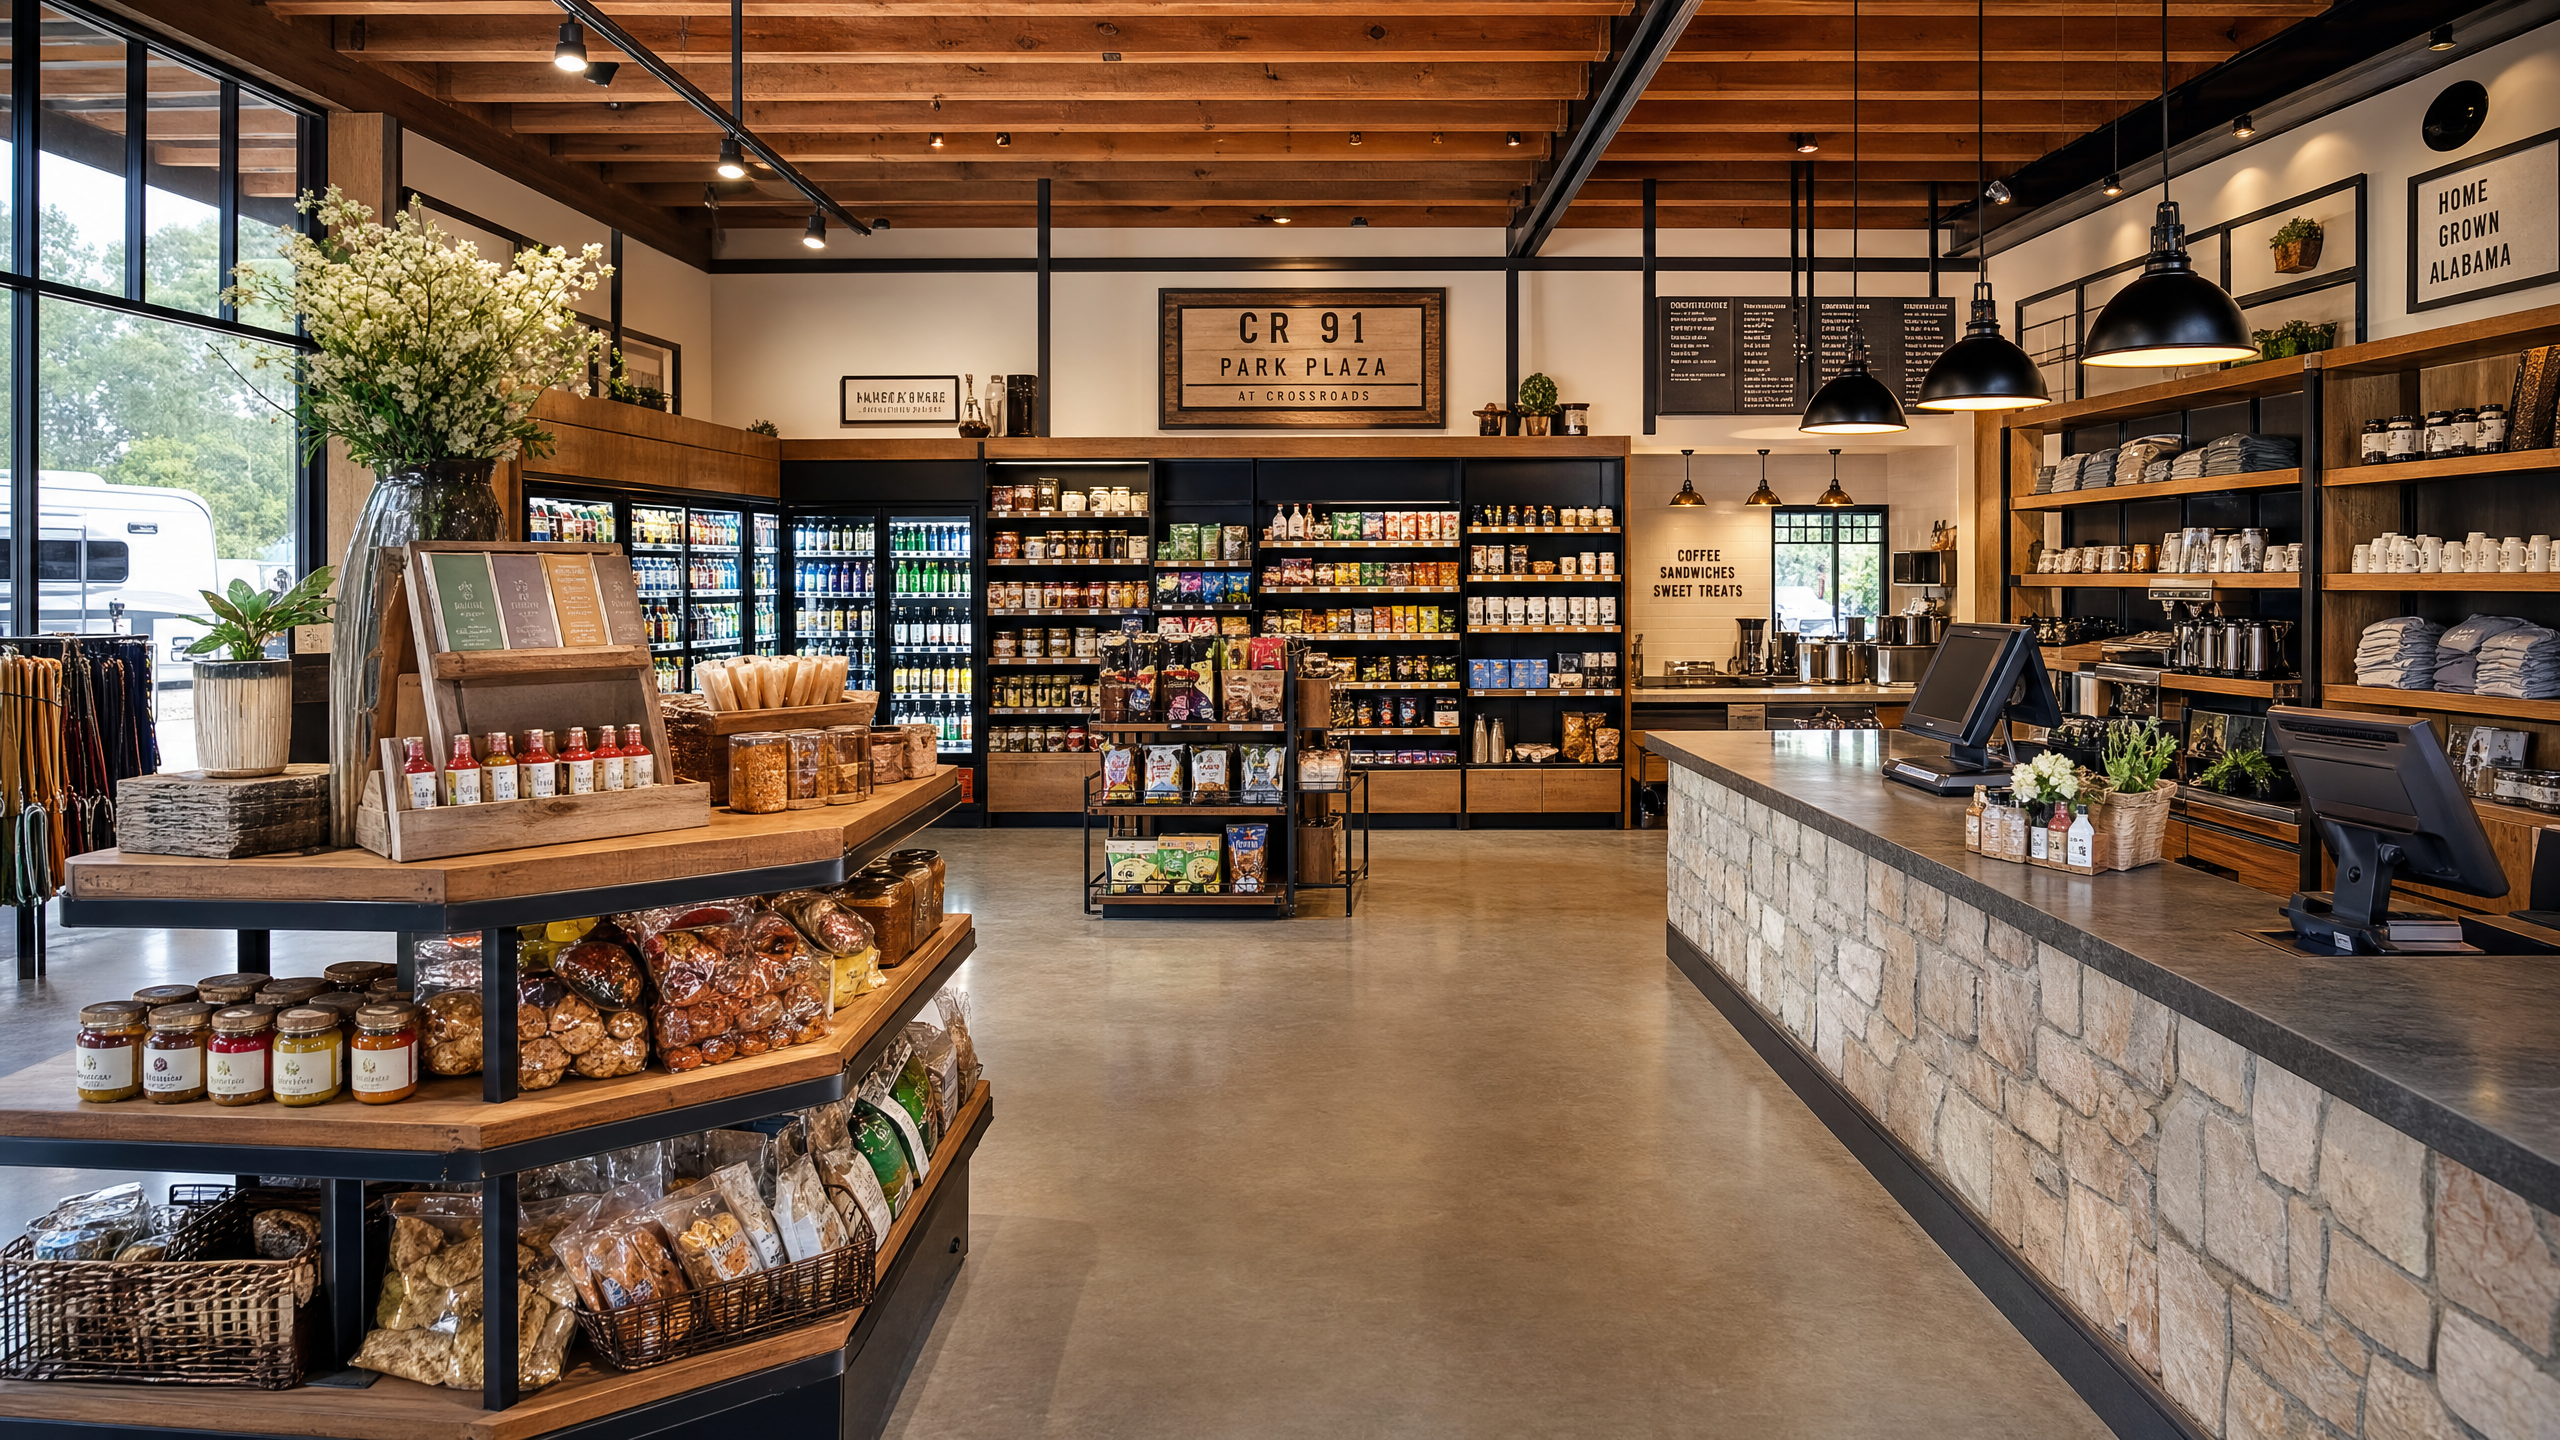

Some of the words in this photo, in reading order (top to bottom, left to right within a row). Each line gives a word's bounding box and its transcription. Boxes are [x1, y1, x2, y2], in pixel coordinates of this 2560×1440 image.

[2438, 178, 2489, 216] HOME
[2438, 210, 2500, 249] GROWN
[2429, 242, 2512, 286] ALABAMA
[1238, 311, 1290, 344] CR
[1320, 311, 1365, 344] 91
[1220, 357, 1287, 377] PARK
[1305, 357, 1386, 377] PLAZA
[1238, 390, 1255, 402] AT
[1266, 390, 1370, 402] CROSSROADS
[1677, 549, 1721, 562] COFFEE
[1660, 566, 1735, 579] SANDWICHES
[1653, 584, 1693, 598] SWEET
[1698, 584, 1743, 598] TREATS
